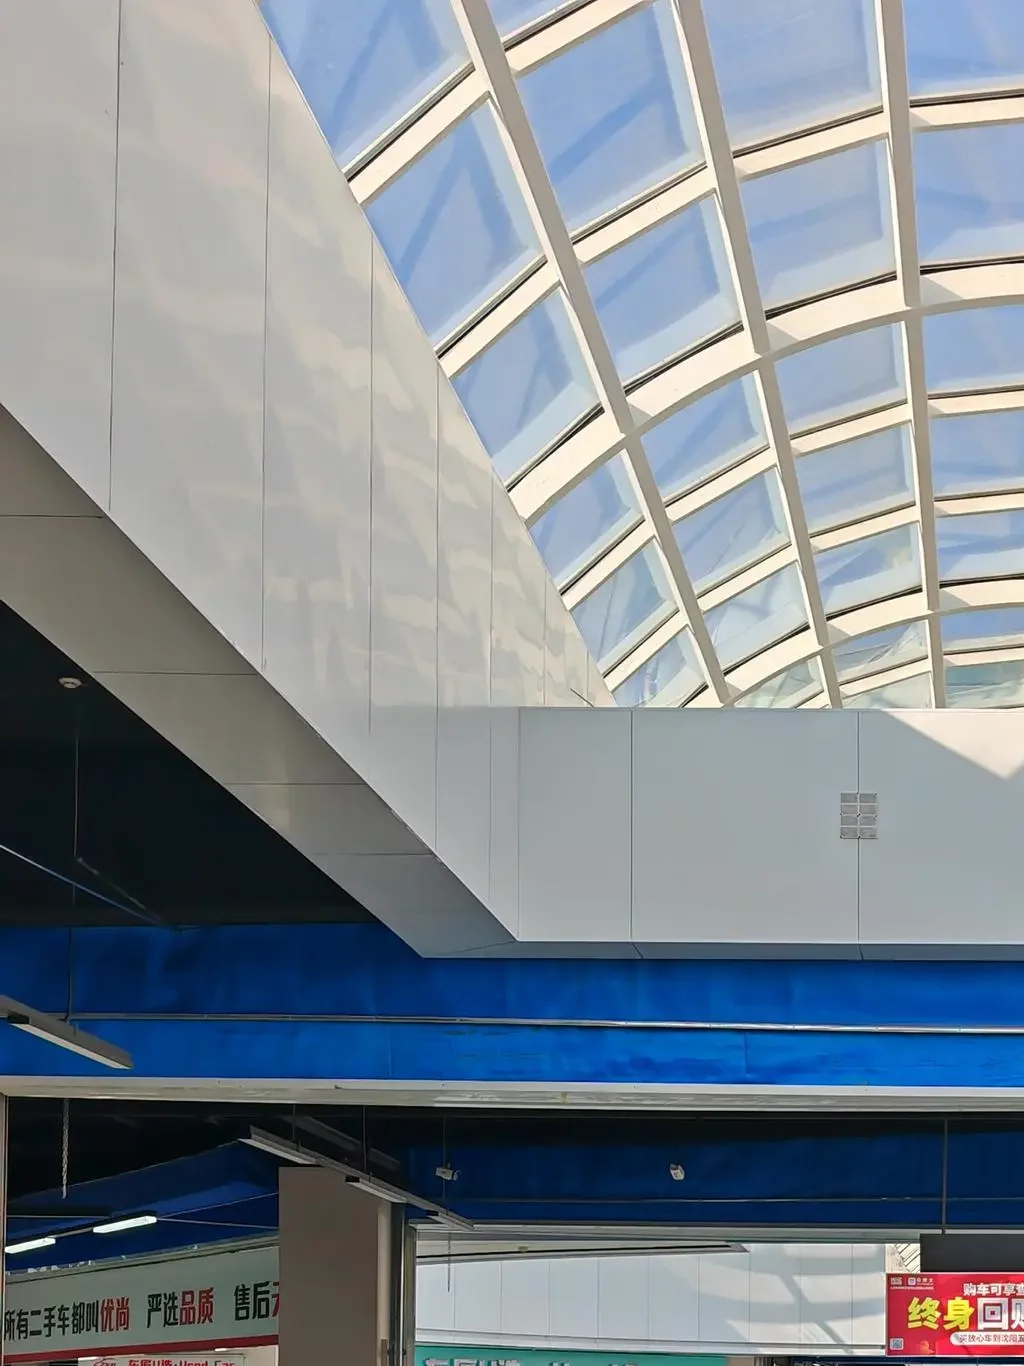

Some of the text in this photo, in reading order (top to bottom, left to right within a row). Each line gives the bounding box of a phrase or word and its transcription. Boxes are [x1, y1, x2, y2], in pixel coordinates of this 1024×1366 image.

[4, 1296, 130, 1341] 所有二手车都叫优尚
[147, 1287, 214, 1328] 严选品质
